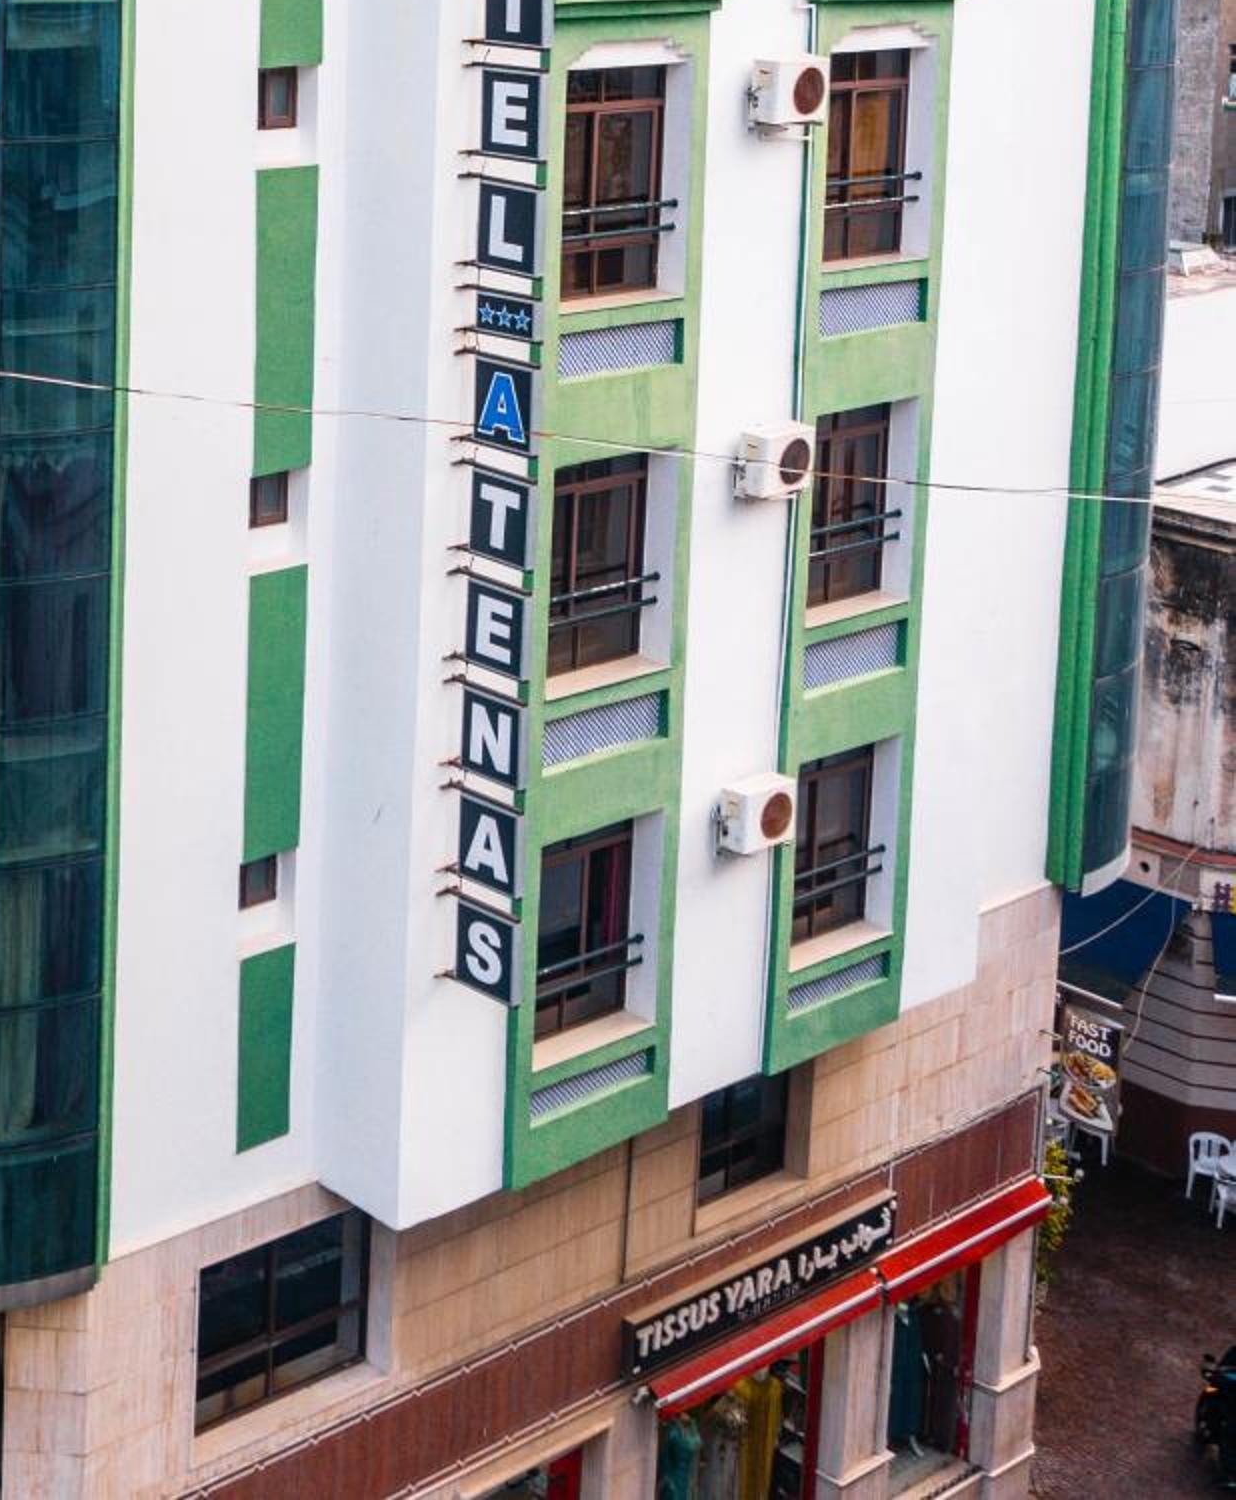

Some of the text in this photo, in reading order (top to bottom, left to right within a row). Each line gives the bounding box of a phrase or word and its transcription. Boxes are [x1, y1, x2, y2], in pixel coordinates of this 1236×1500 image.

[464, 371, 526, 982] ATENAS
[1068, 1029, 1111, 1057] FOOD
[1070, 1015, 1112, 1040] FAST
[636, 1289, 721, 1357] TISSUS
[723, 1258, 791, 1313] YARA
